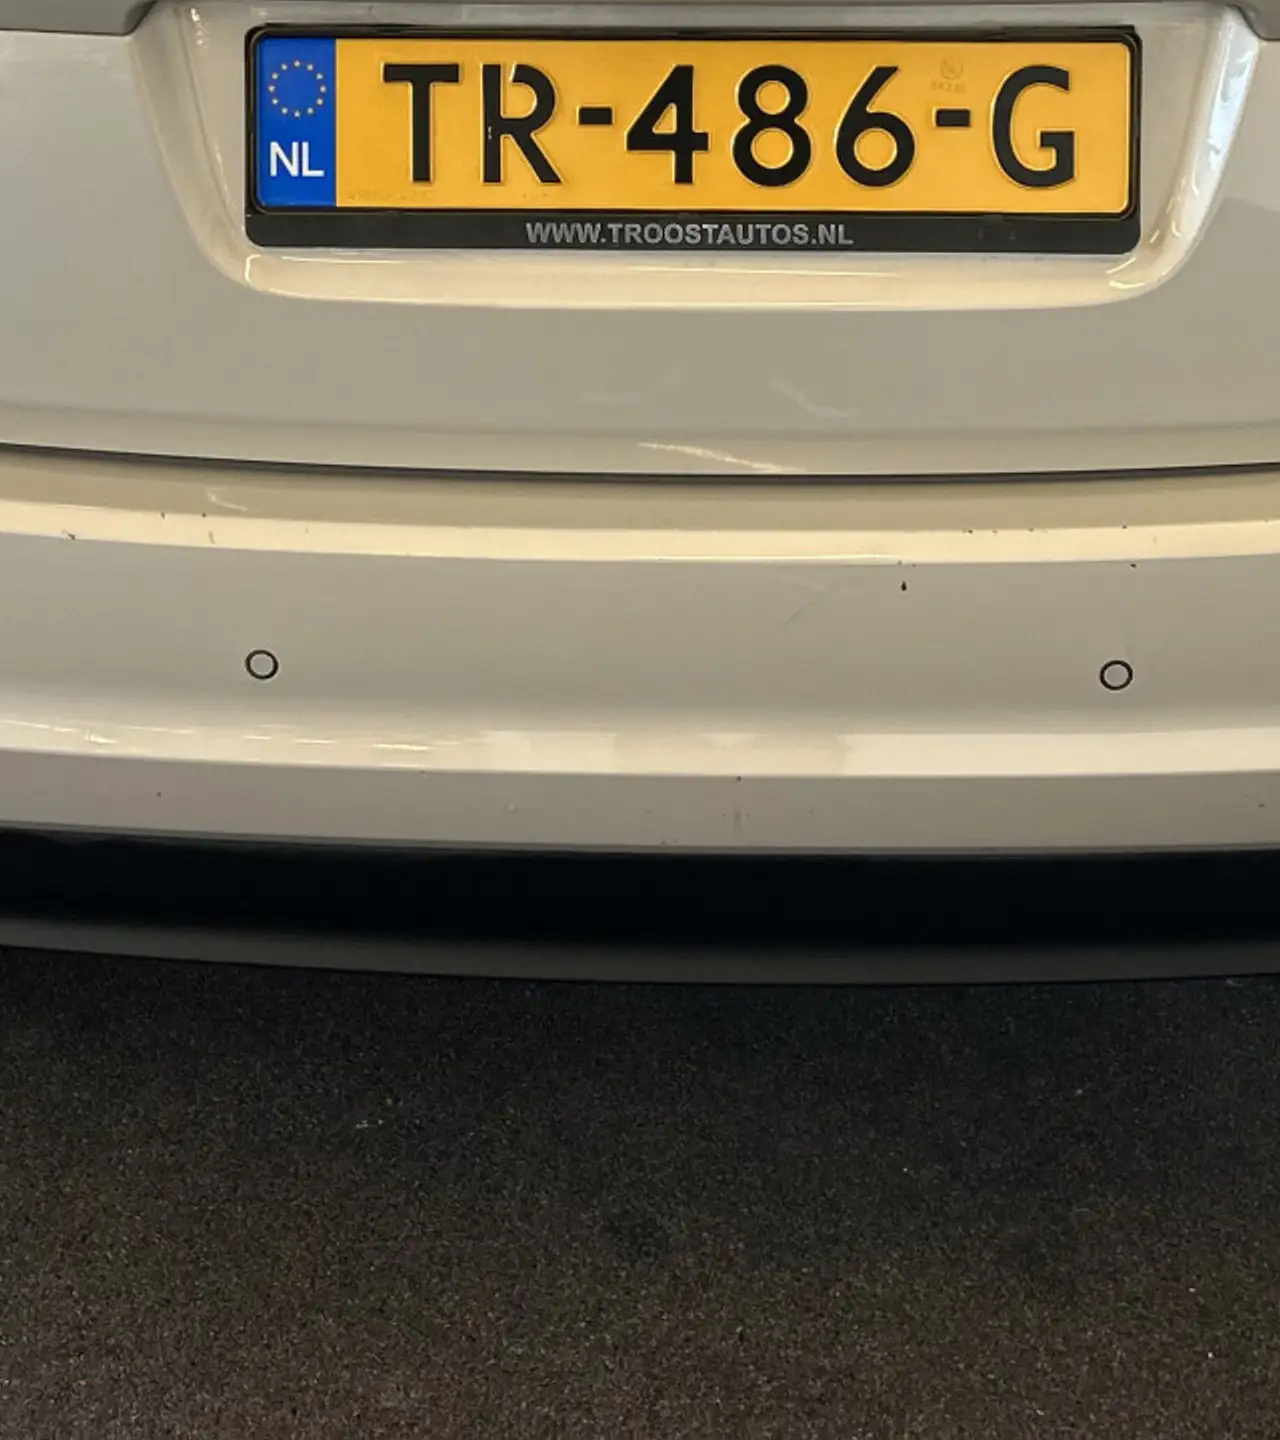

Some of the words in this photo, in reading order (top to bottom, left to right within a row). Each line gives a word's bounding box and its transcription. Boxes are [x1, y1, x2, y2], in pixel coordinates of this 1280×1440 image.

[269, 140, 324, 179] NL
[381, 61, 1078, 191] TR-486-G
[524, 220, 854, 249] WWW.TROOSTAUTOS.NL
